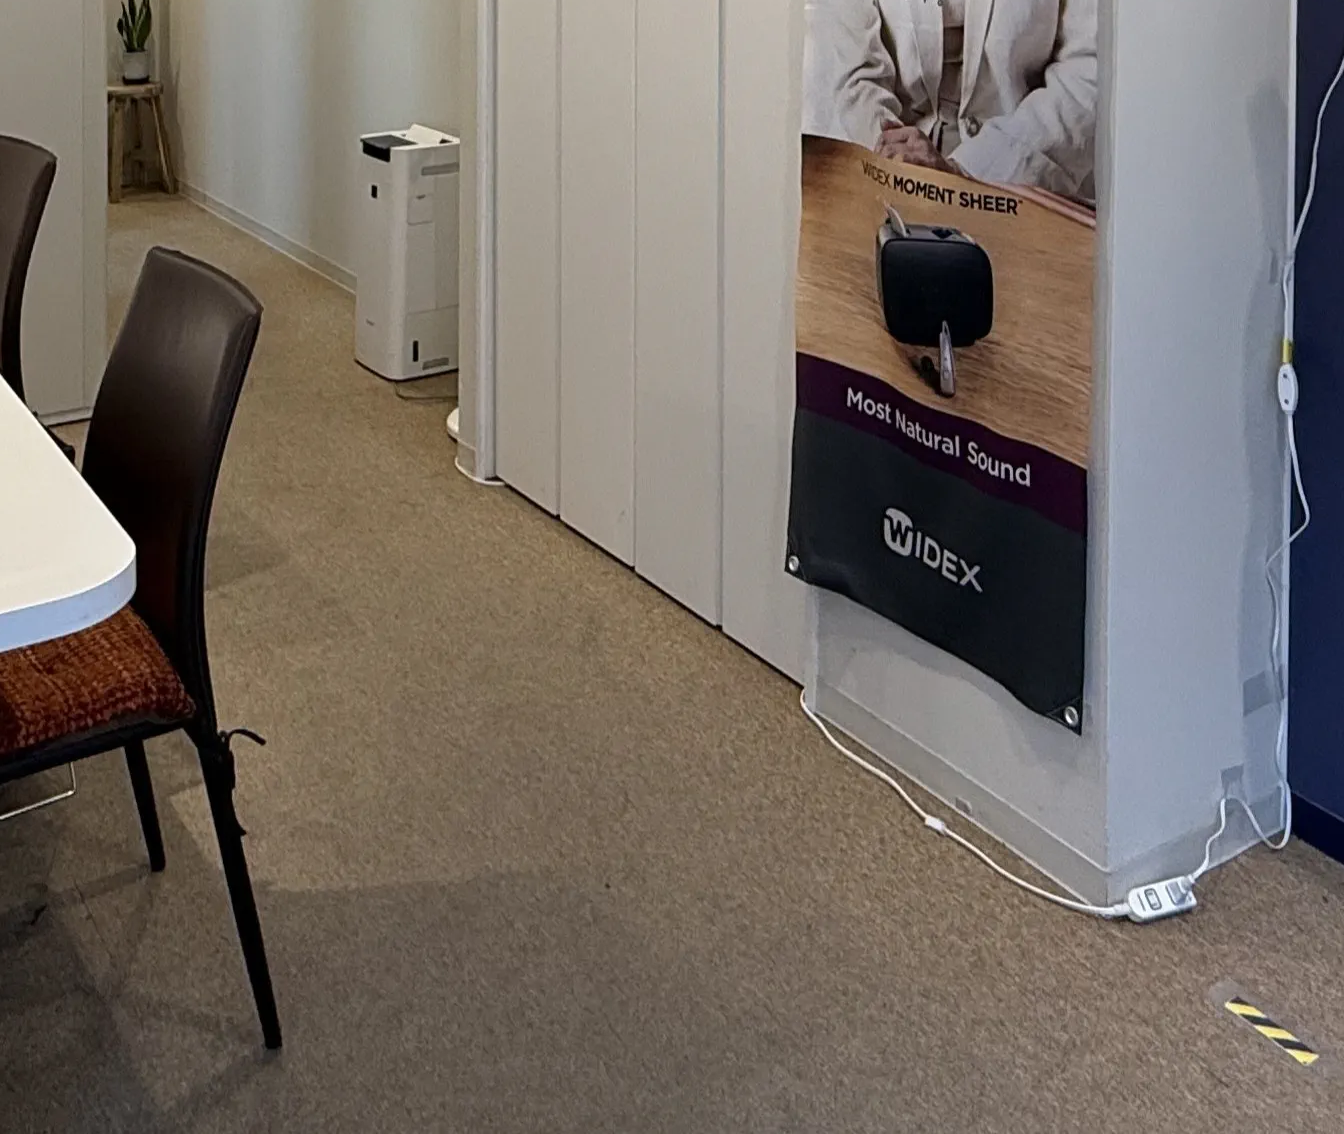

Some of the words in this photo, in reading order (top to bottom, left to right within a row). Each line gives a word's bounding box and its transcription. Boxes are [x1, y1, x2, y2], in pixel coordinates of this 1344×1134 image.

[893, 175, 955, 205] MOMENT
[959, 192, 1018, 215] SHEER
[847, 387, 892, 424] Most
[895, 409, 960, 458] Natural
[967, 441, 1031, 487] Sound
[883, 507, 984, 594] WIDEX
